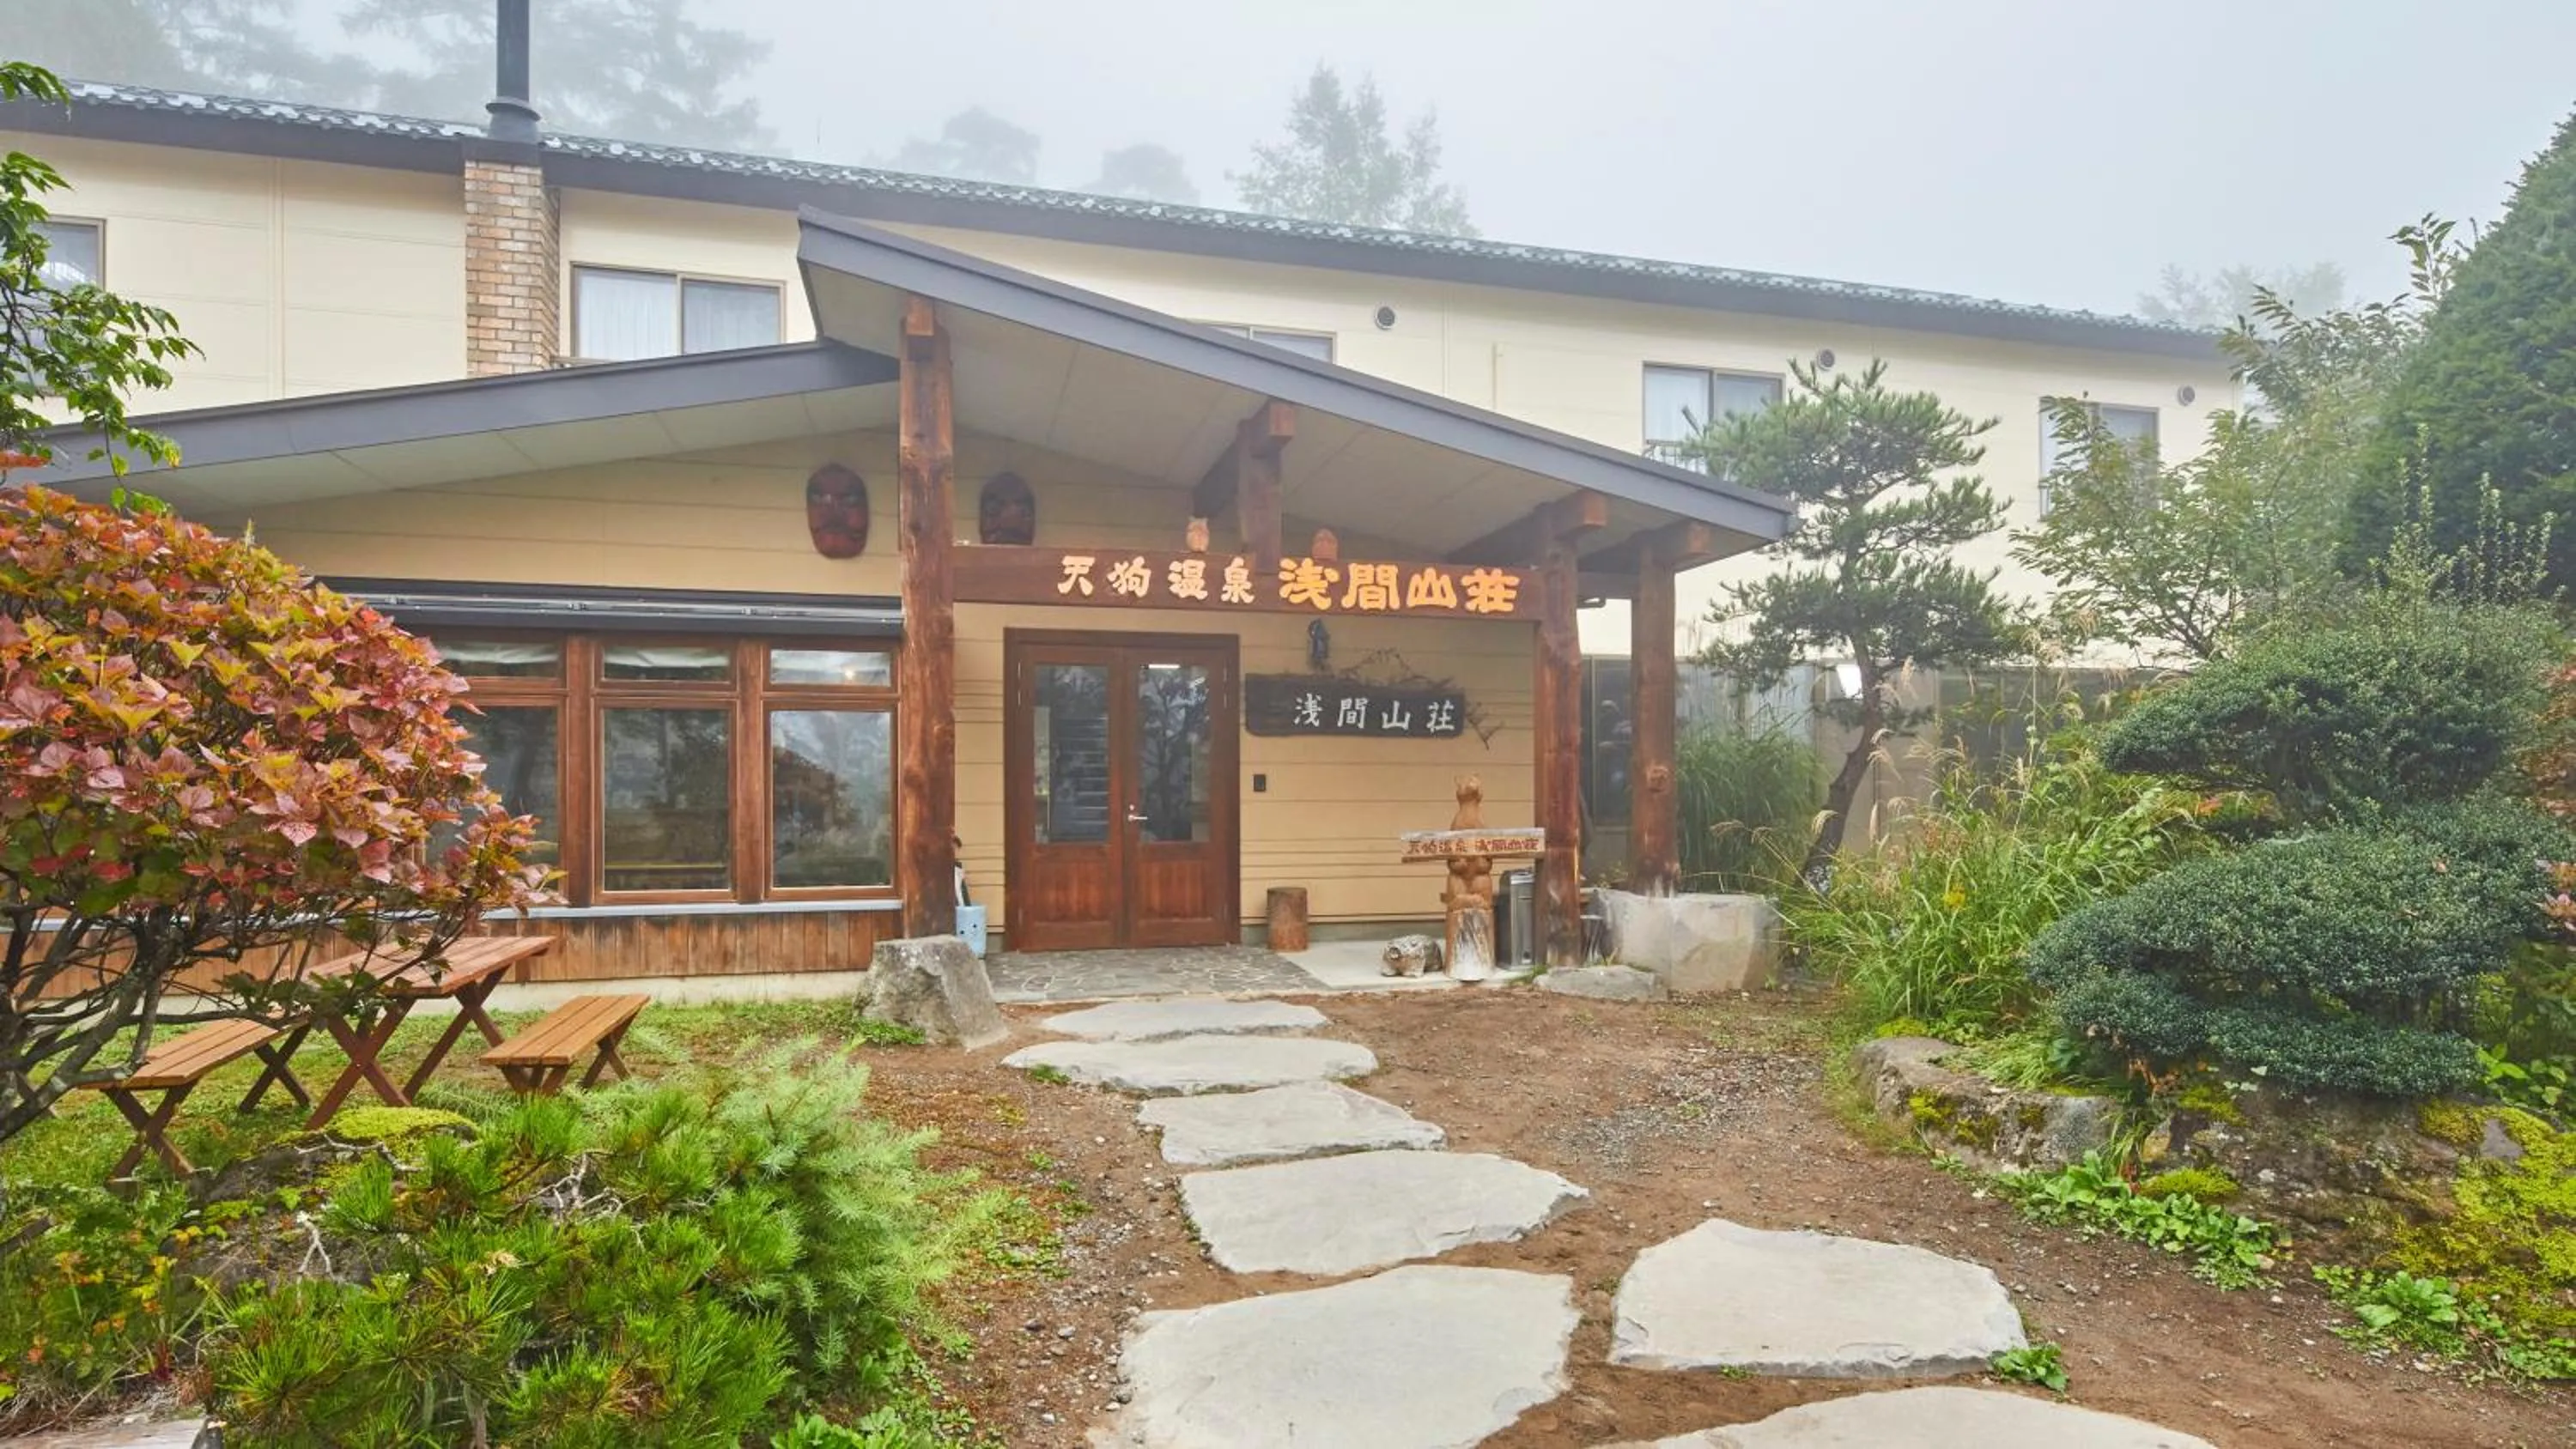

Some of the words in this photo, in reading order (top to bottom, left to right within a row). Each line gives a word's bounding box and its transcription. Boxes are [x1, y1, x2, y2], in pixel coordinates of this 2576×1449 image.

[1057, 555, 1255, 603] 天狗温泉
[1278, 557, 1521, 614] 浅間山荘
[1293, 692, 1455, 732] 浅間山荘
